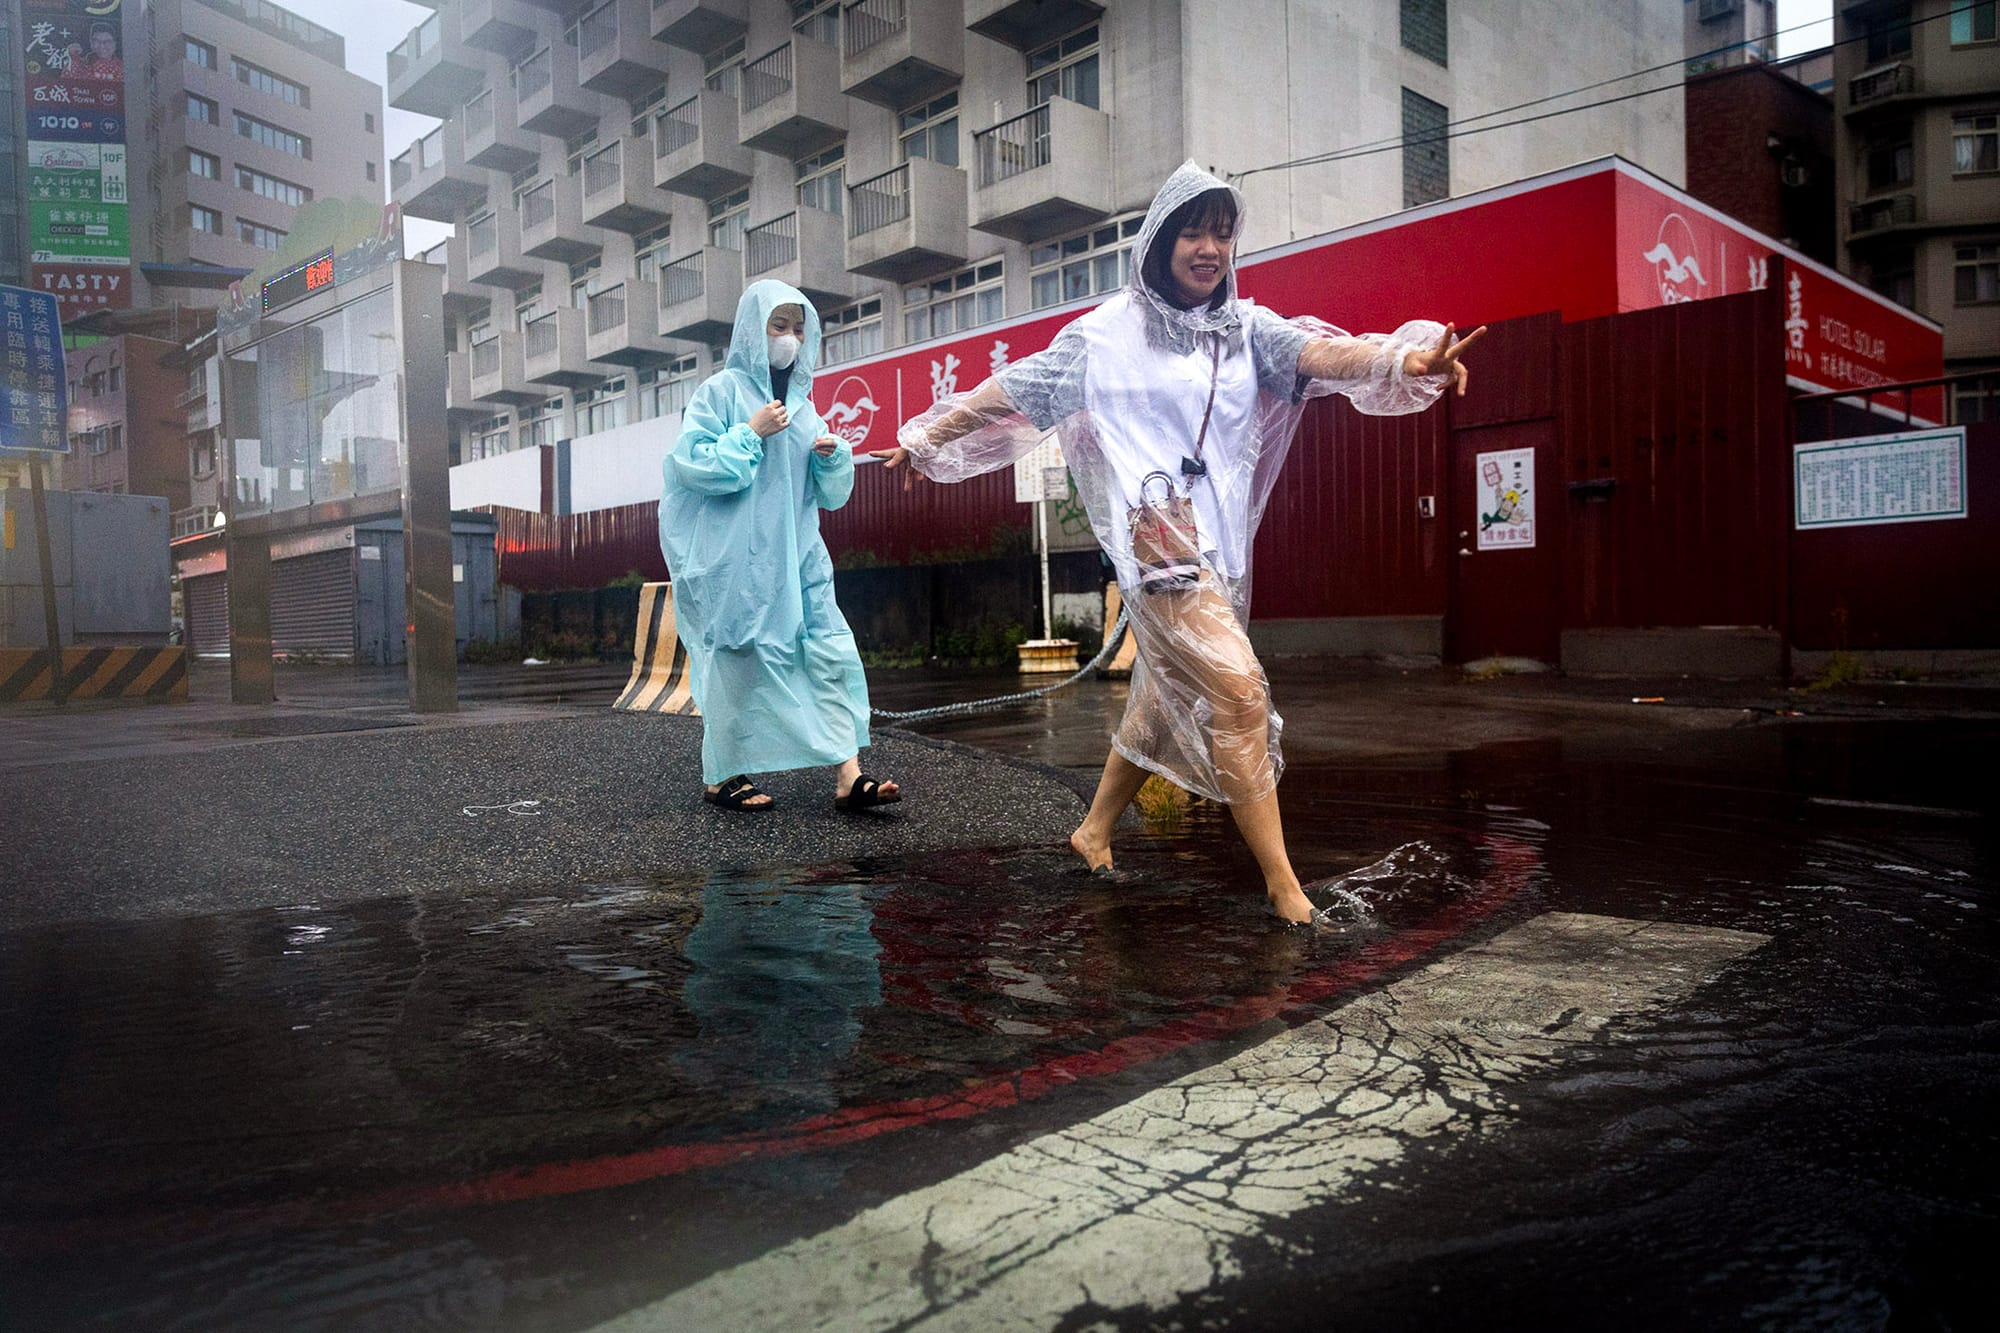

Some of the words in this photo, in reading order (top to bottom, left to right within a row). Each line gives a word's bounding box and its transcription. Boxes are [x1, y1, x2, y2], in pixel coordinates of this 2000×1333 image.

[33, 85, 70, 104] 瓦城
[38, 116, 79, 129] 1010
[103, 152, 123, 163] 10F
[36, 252, 50, 261] 7F
[42, 274, 120, 290] TASTY
[1819, 315, 1853, 351] HOTEL
[1853, 330, 1887, 364] SOLAR
